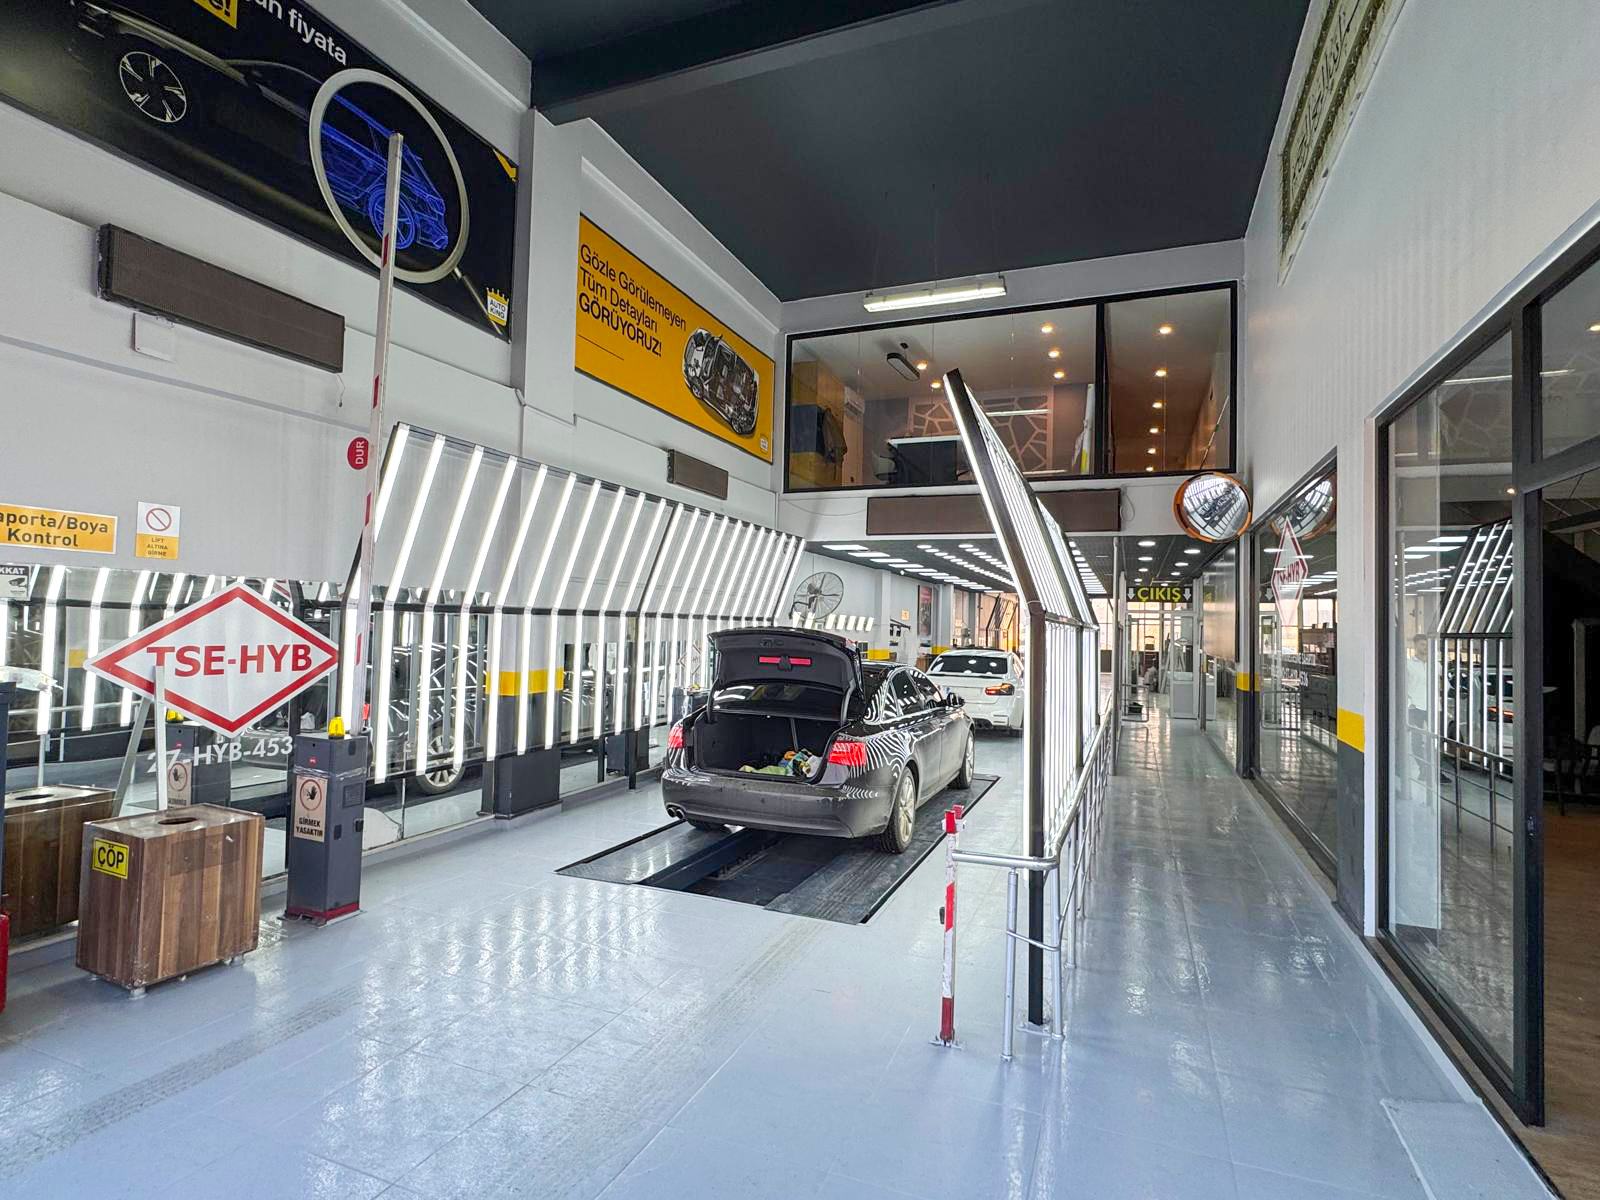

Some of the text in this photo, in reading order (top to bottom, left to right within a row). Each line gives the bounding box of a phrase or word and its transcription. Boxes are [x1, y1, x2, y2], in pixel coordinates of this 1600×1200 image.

[288, 8, 348, 66] fiyata
[579, 266, 658, 333] Tüm Detayları
[580, 243, 687, 332] Gözle Görülemeyen
[490, 299, 506, 312] AUTO
[490, 306, 505, 319] KING
[579, 292, 662, 357] GÖRÜYORUZ!
[355, 440, 365, 465] DUR
[7, 528, 79, 547] Kontrol
[1137, 587, 1182, 602] ÇIKIŞ
[146, 644, 313, 677] TSE-HYB
[298, 817, 321, 828] GİRMEK
[97, 843, 124, 869] ÇÖP
